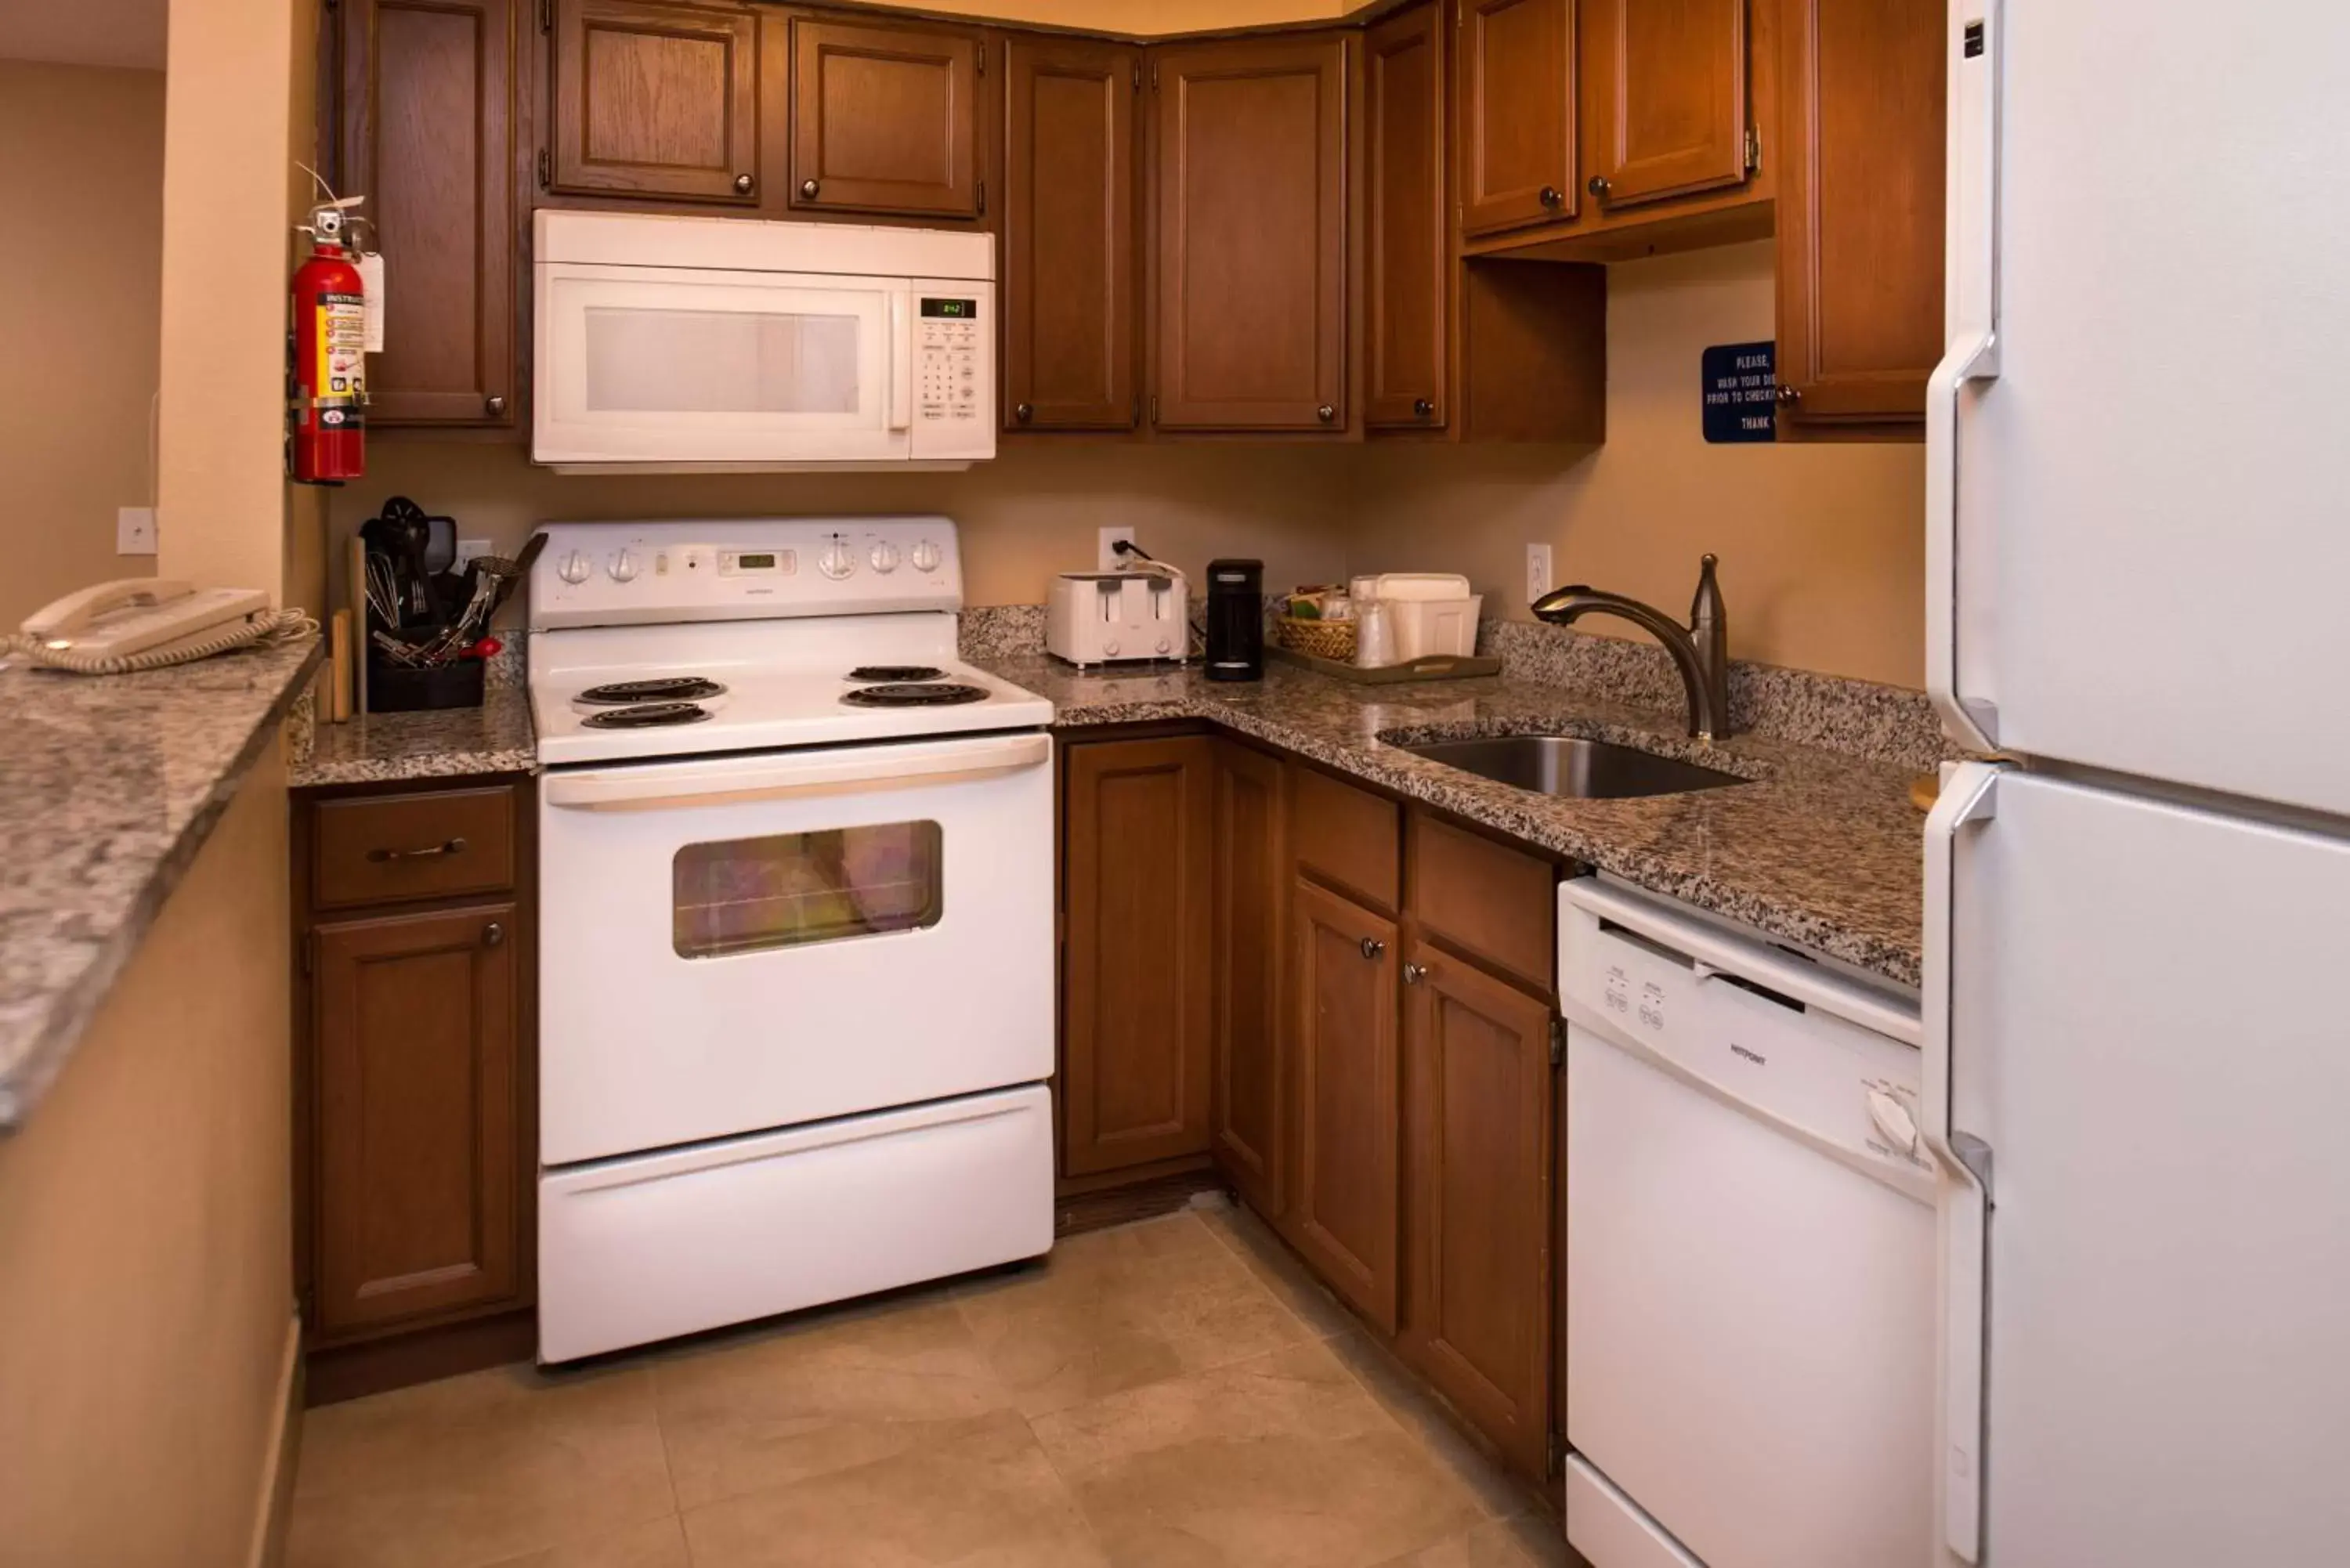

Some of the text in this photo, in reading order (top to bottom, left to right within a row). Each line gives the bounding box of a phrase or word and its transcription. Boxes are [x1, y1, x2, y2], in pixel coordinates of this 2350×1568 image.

[1737, 354, 1770, 370] PLEASE,
[1718, 377, 1737, 388] WASH
[1741, 375, 1760, 387] YOUR
[1707, 392, 1729, 404] PRIOR
[1732, 391, 1742, 403] TO
[1741, 416, 1770, 429] THANK
